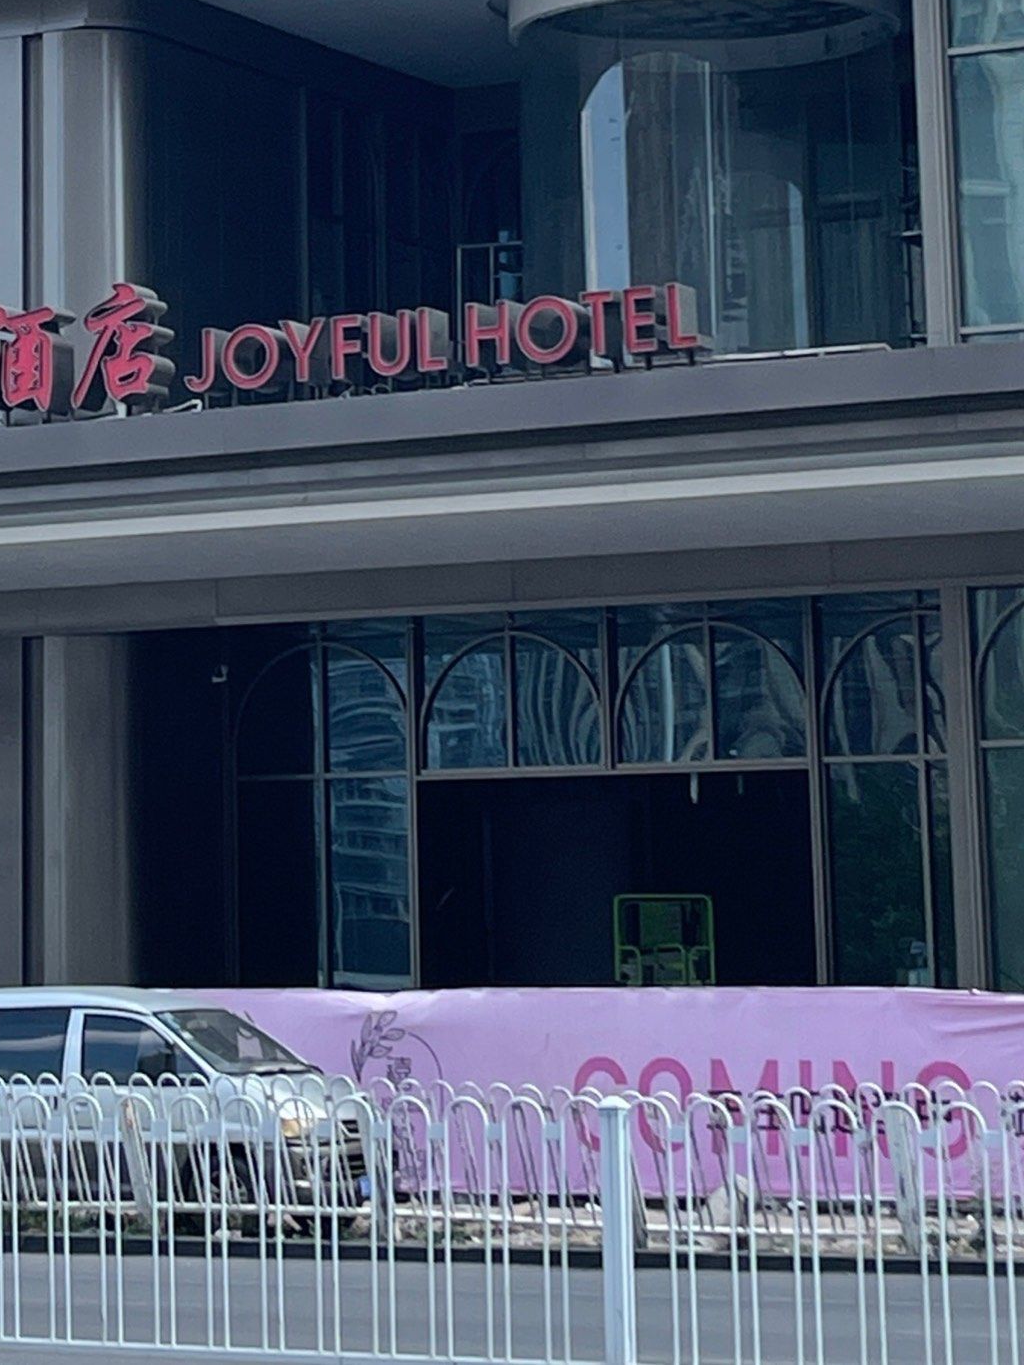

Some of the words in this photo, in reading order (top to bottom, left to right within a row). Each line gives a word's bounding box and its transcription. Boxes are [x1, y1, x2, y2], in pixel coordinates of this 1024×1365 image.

[184, 309, 449, 393] JOYFUL
[465, 283, 699, 369] HOTEL
[574, 1055, 973, 1161] COMING
